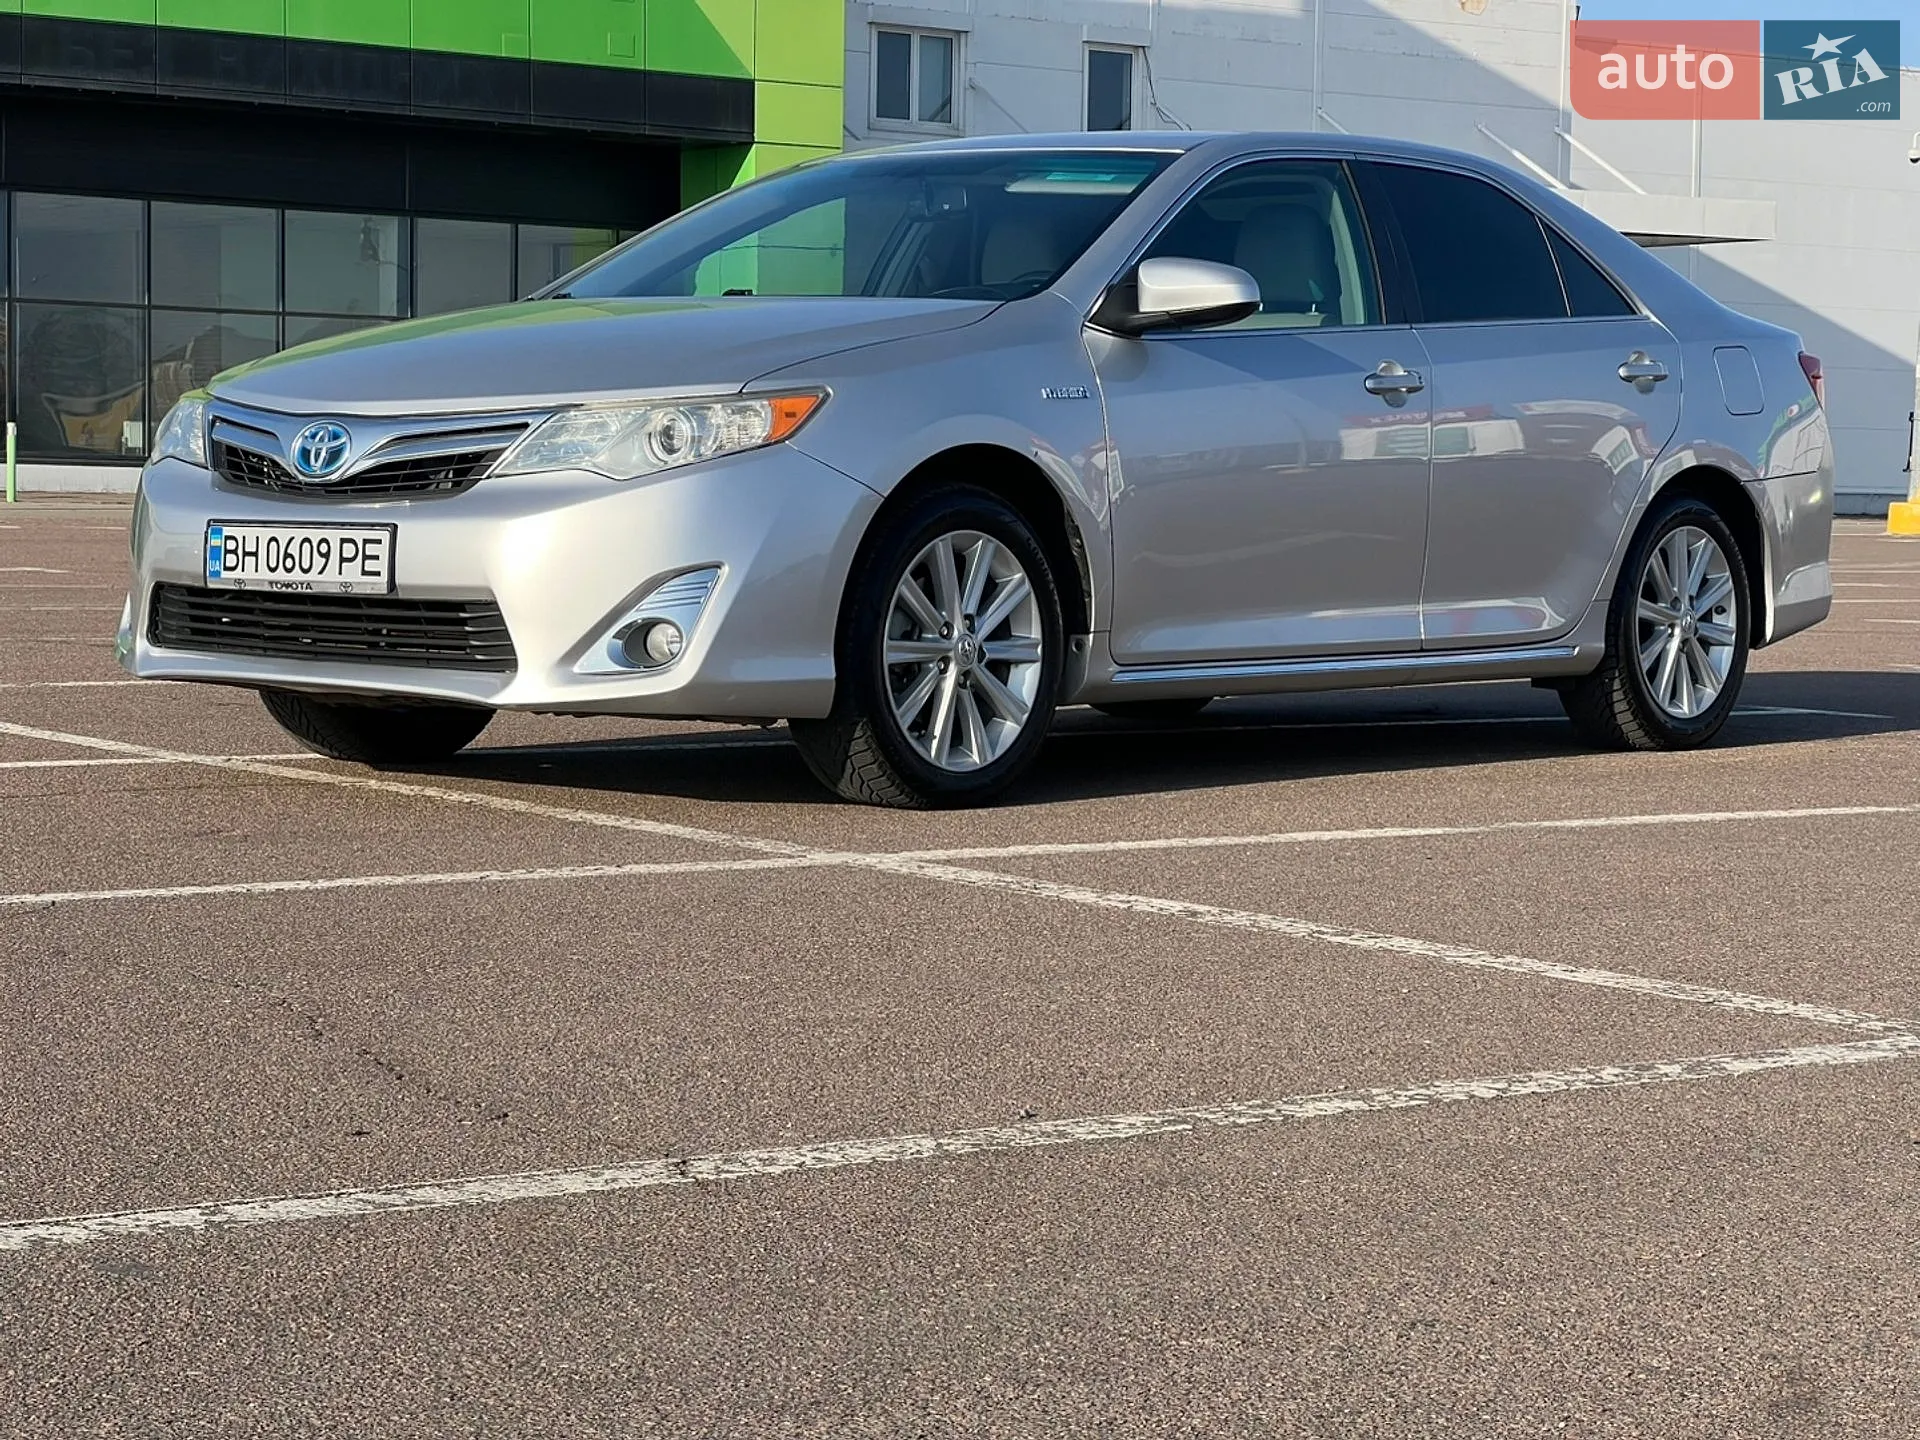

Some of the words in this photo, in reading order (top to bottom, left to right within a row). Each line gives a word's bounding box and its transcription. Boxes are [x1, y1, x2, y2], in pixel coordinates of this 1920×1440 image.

[223, 535, 259, 573] BH
[266, 536, 332, 575] 0609
[338, 537, 382, 577] PE
[209, 560, 221, 572] UA
[267, 581, 313, 591] TOYOTA
